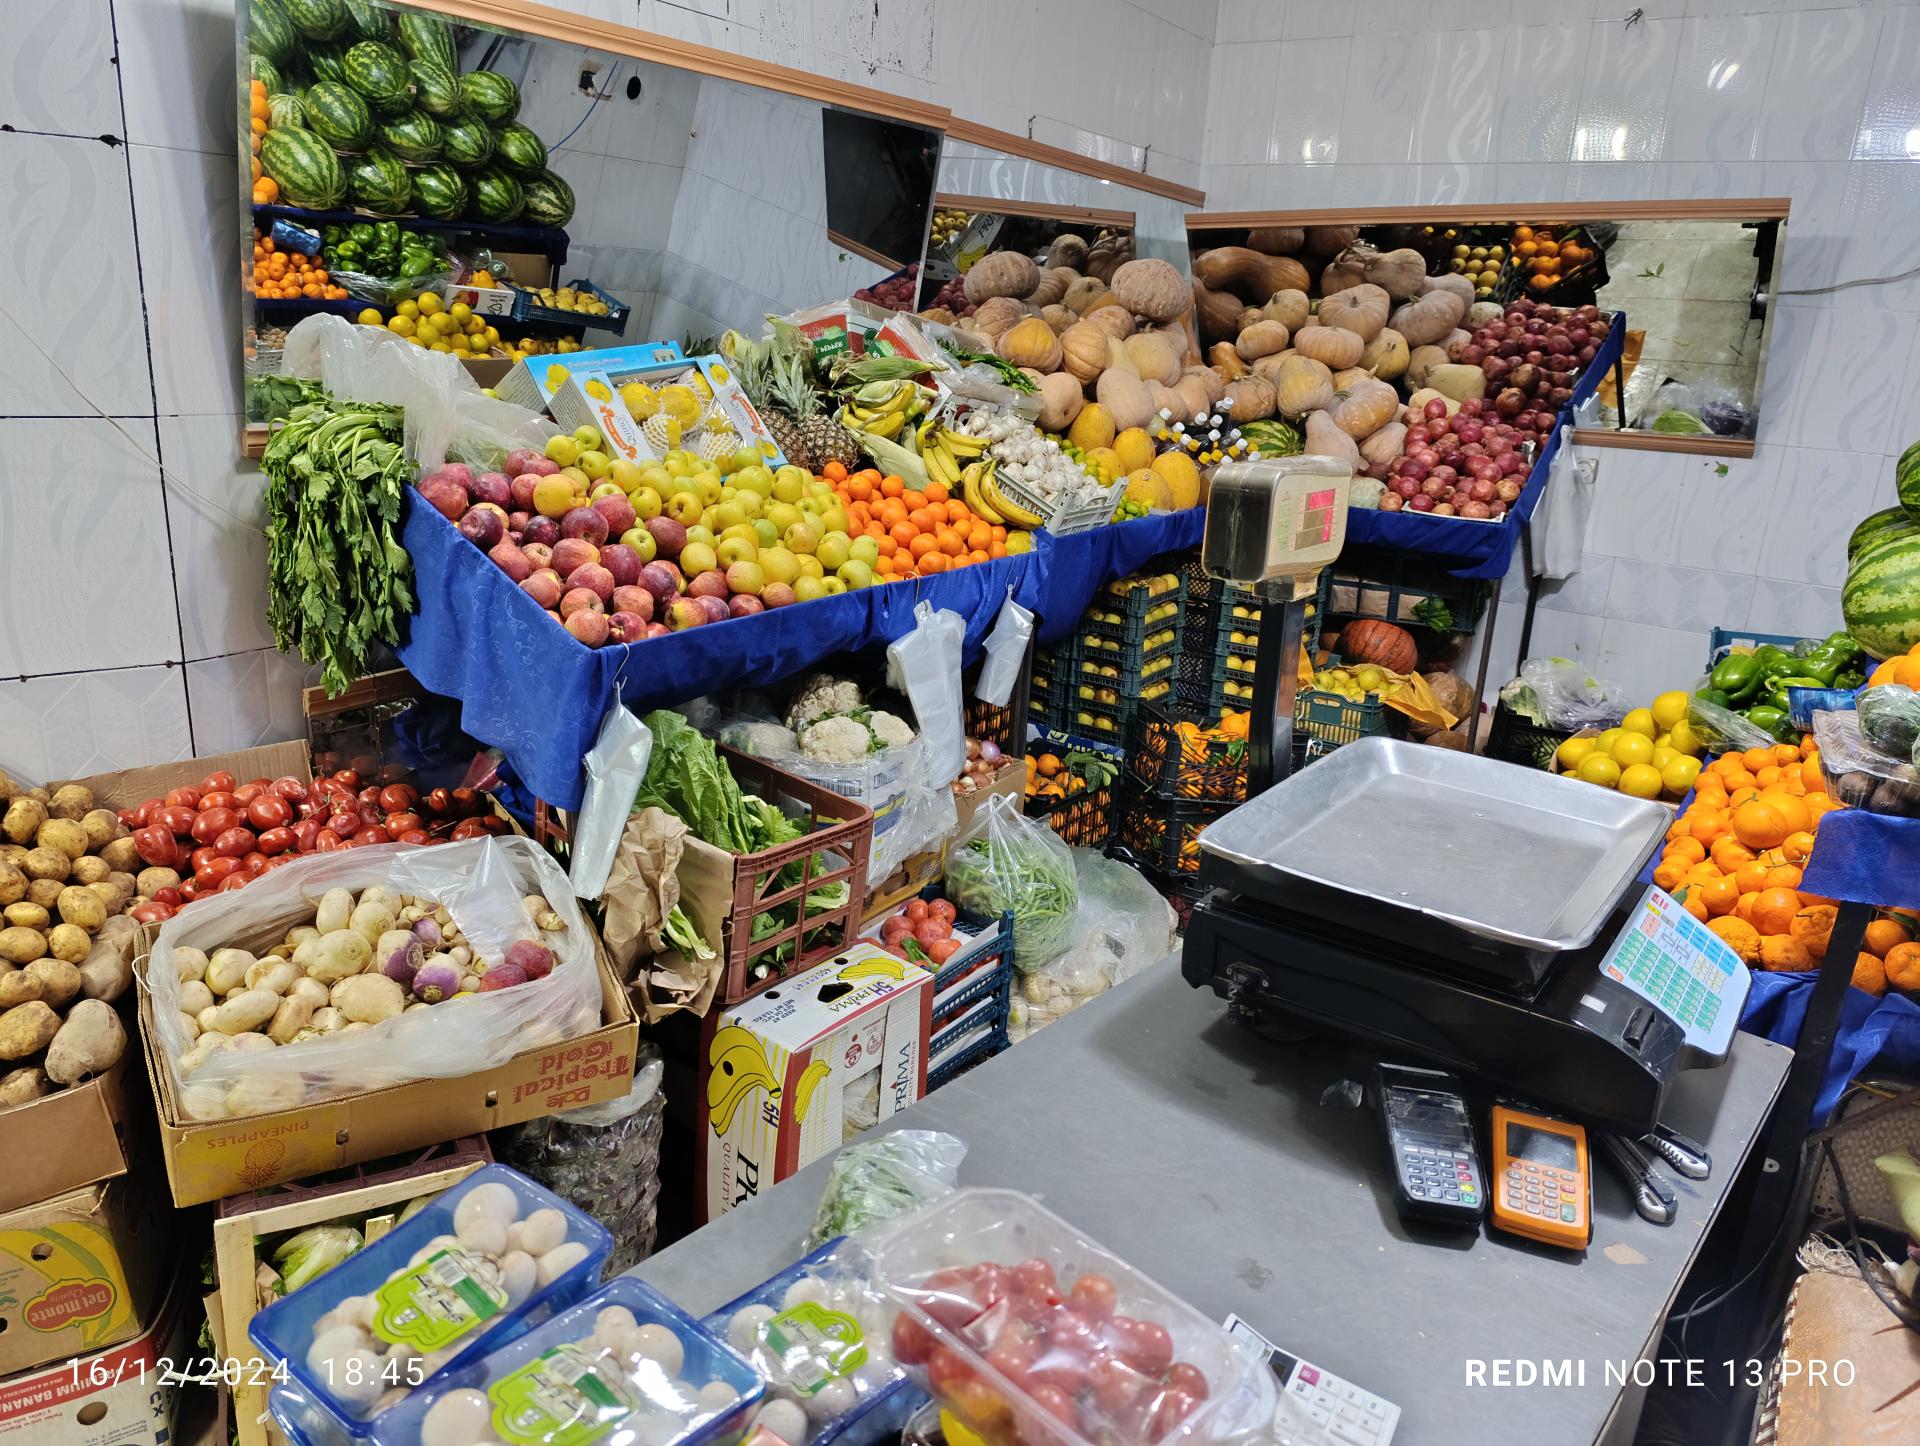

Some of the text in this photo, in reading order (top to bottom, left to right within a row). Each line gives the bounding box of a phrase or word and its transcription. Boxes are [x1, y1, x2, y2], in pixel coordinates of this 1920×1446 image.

[829, 989, 872, 1012] PRIMA
[539, 1040, 614, 1075] Gold
[512, 1055, 630, 1105] Tropical
[893, 1041, 911, 1115] PRIMA
[546, 1085, 592, 1108] Dole
[762, 1101, 780, 1128] 5H
[207, 1120, 309, 1149] PINEAPPLES
[719, 1143, 731, 1205] QUALITY
[30, 1290, 109, 1323] Del Monte
[0, 1388, 53, 1413] BANAN
